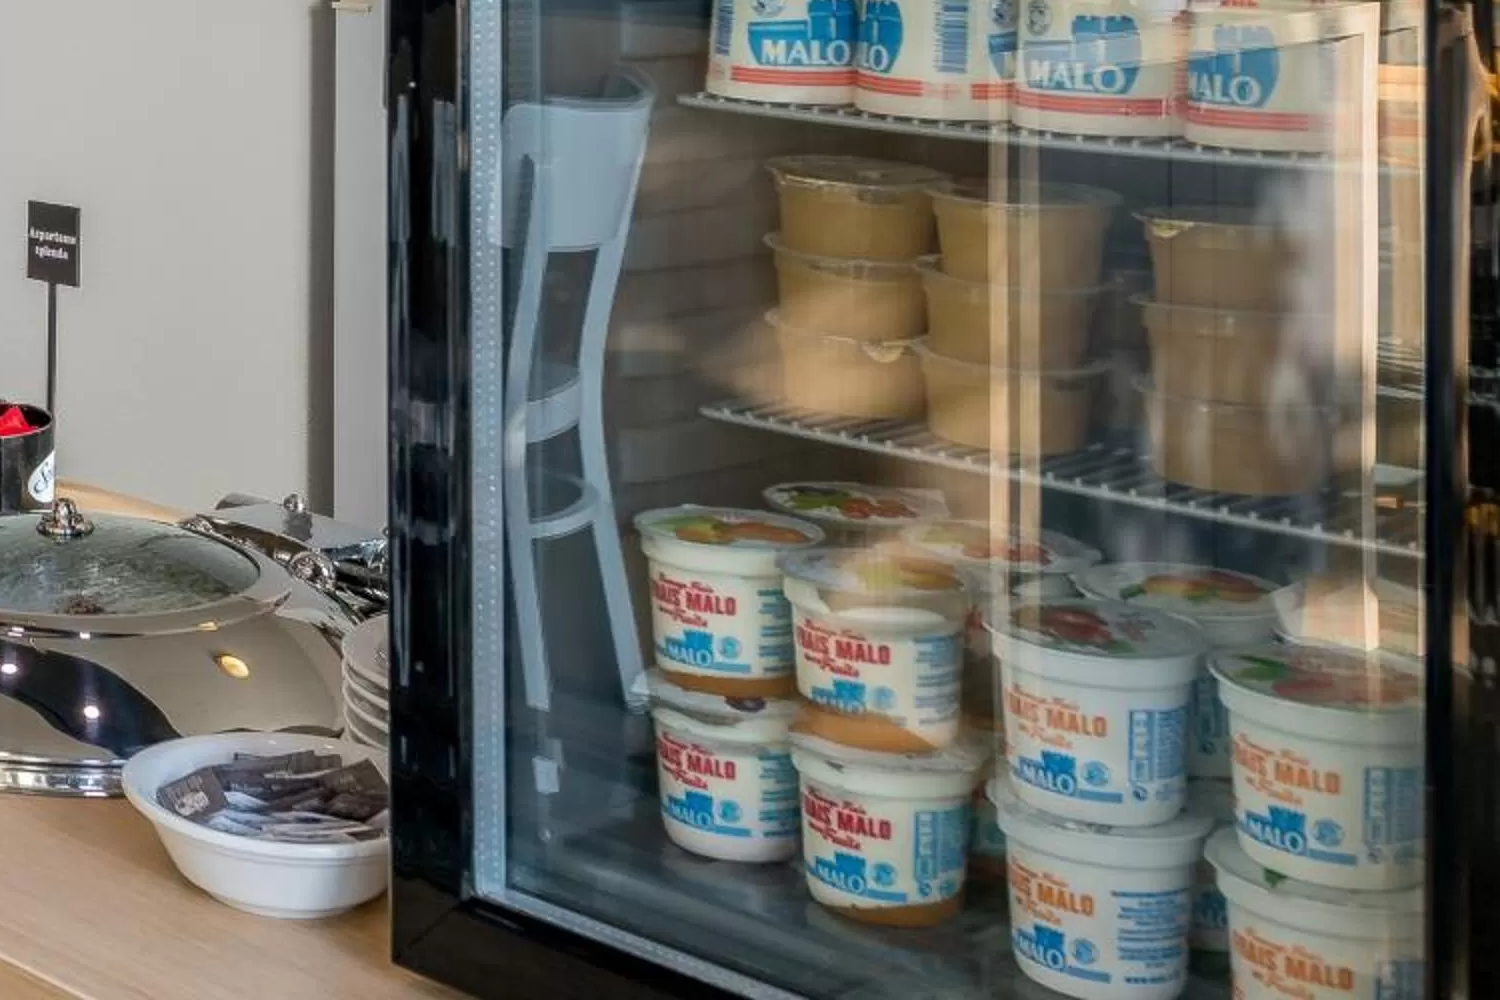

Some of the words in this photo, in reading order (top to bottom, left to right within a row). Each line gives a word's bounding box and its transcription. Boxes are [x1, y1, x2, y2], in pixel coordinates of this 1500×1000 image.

[761, 39, 850, 65] MALO
[1029, 60, 1126, 94] MALO
[686, 591, 737, 616] MALO
[835, 637, 891, 664] MALO
[1047, 707, 1109, 738] MALO
[687, 751, 736, 780] MALO
[1019, 760, 1076, 794] MALO
[1275, 759, 1341, 795] MALO
[836, 809, 892, 840] MALO
[1244, 814, 1306, 853] MALO
[1037, 883, 1094, 917] MALO
[1285, 955, 1355, 990] MALO
